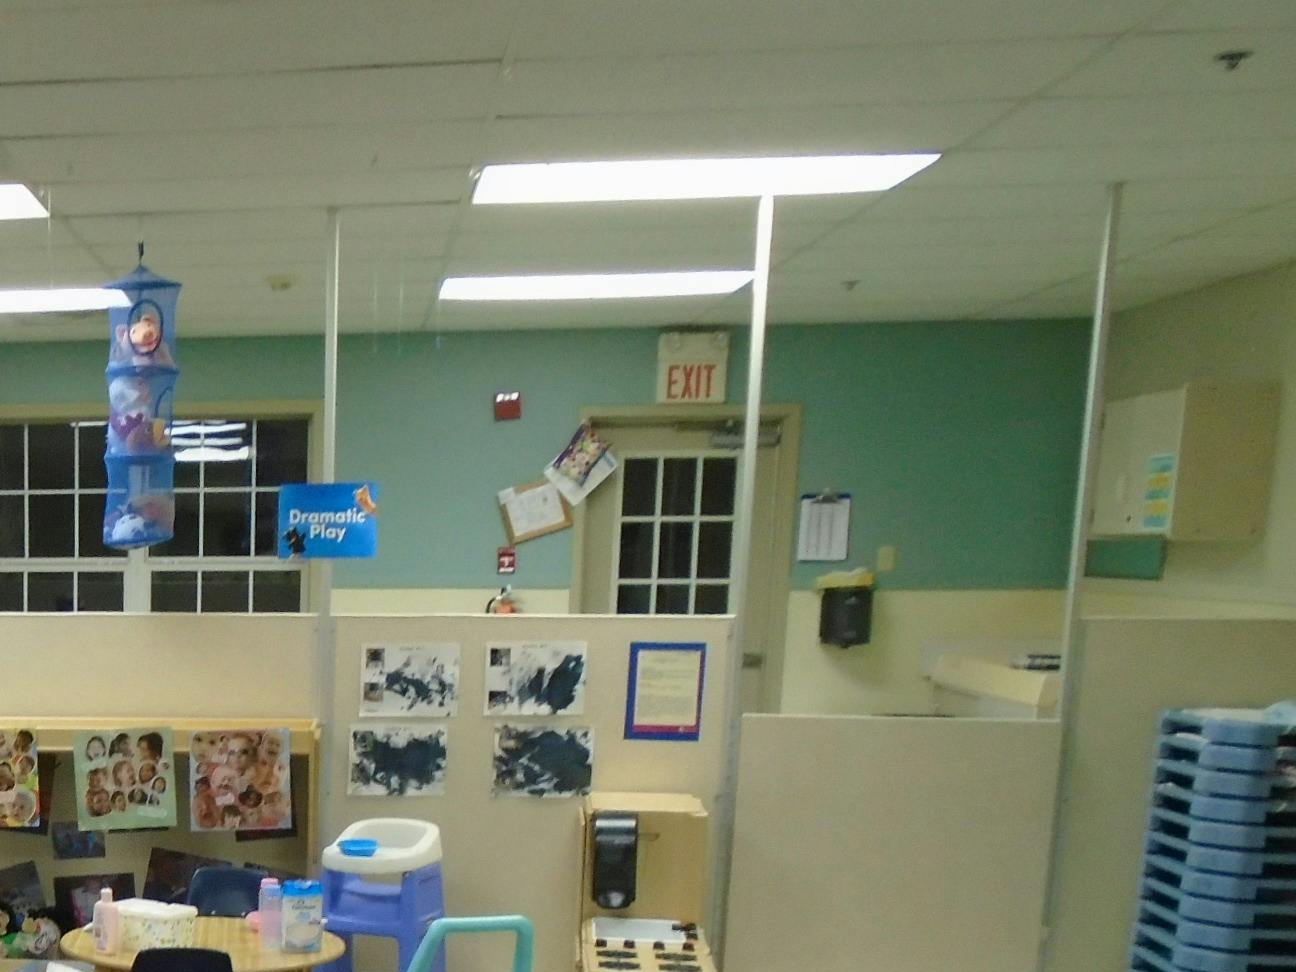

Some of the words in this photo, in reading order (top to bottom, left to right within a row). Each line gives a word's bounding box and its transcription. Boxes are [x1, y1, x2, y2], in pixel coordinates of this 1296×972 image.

[666, 364, 717, 400] EXIT
[289, 508, 366, 525] Dramatic
[310, 524, 346, 544] Play
